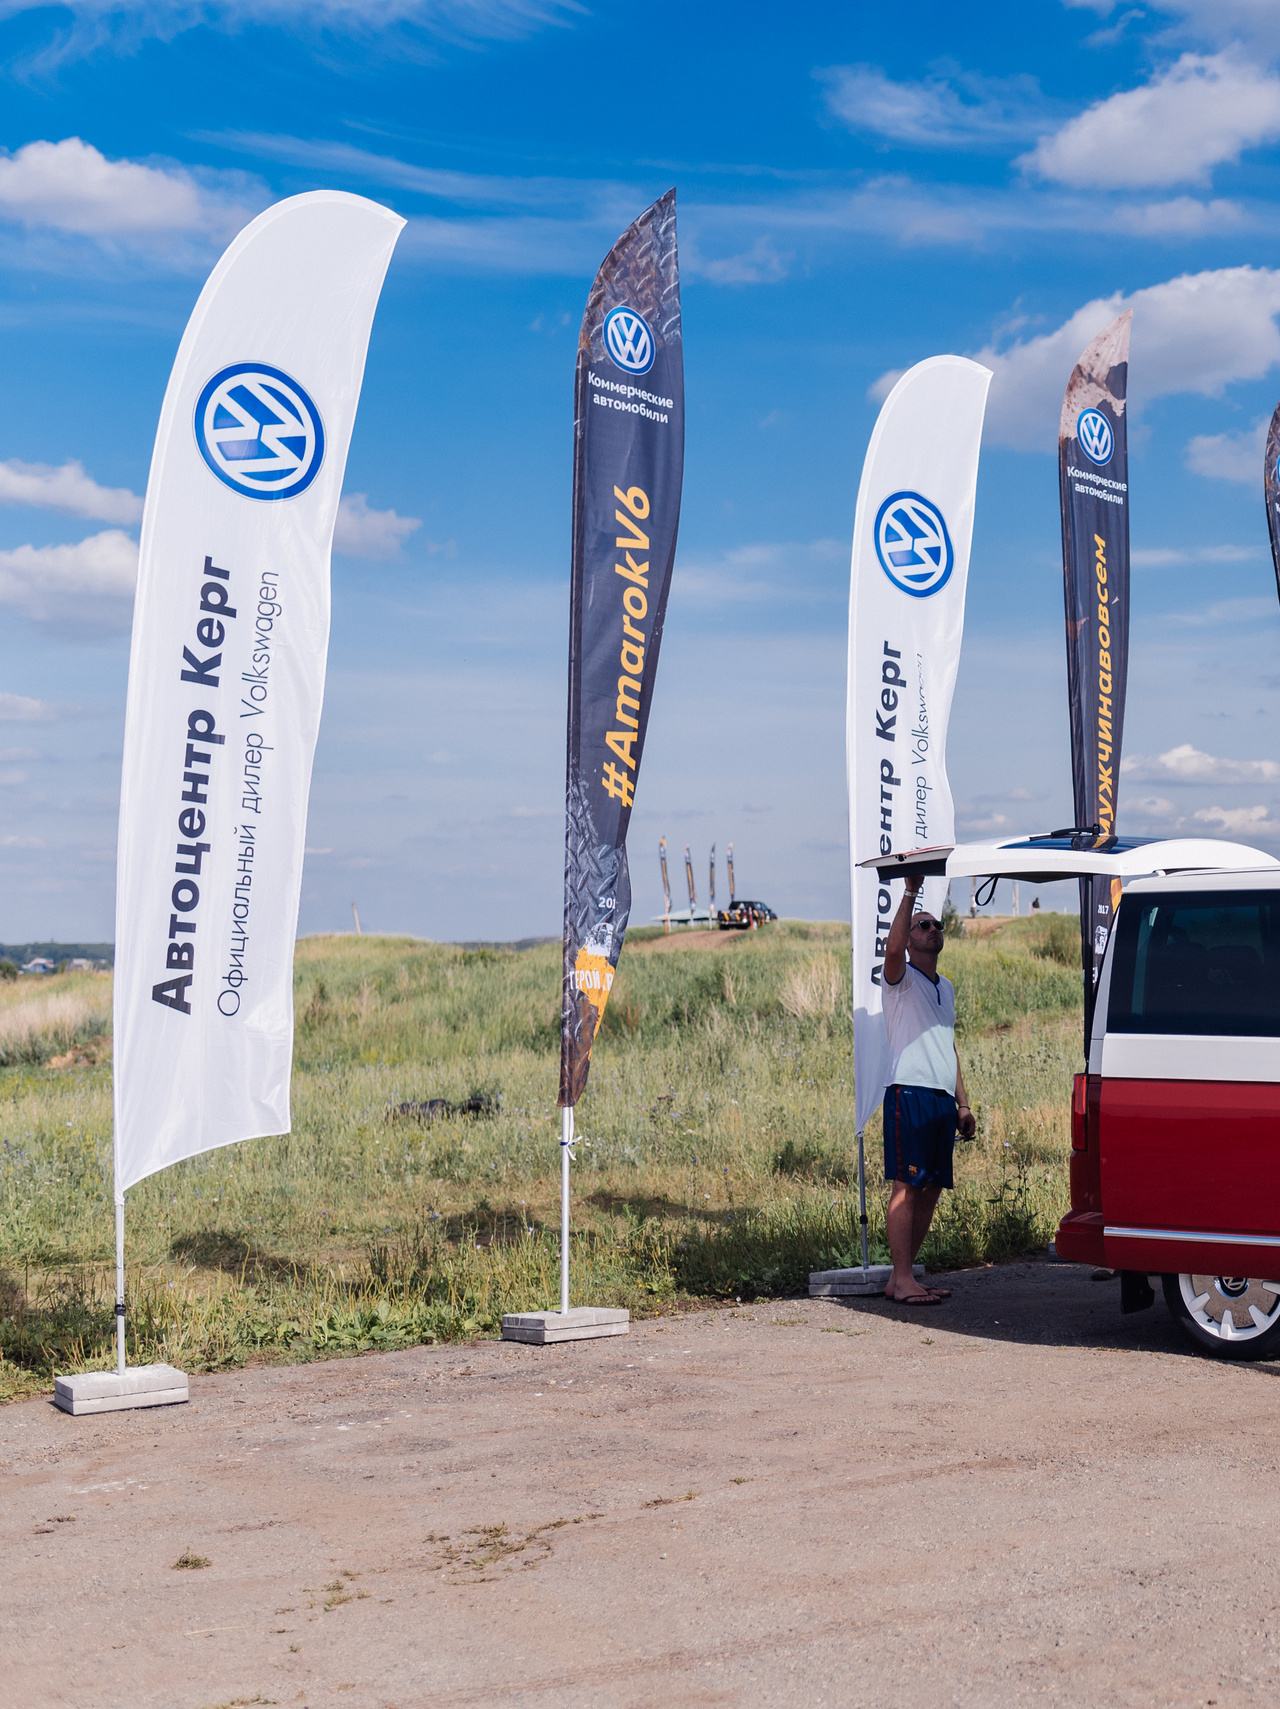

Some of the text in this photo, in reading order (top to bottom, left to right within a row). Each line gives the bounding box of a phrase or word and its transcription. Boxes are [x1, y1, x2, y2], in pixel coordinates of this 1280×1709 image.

[587, 371, 674, 410] Коммерческие
[592, 391, 669, 424] автомобили
[1067, 466, 1128, 492] Коммерческие
[601, 485, 651, 808] #AmarokV6
[1094, 534, 1114, 837] мужчинавовсем
[151, 555, 238, 1017] Автоцентр Керг
[217, 570, 283, 1018] Официальный дилер Volkswagen
[870, 639, 908, 988] Автоентр Керг
[915, 775, 933, 840] дилер
[598, 897, 616, 909] 201
